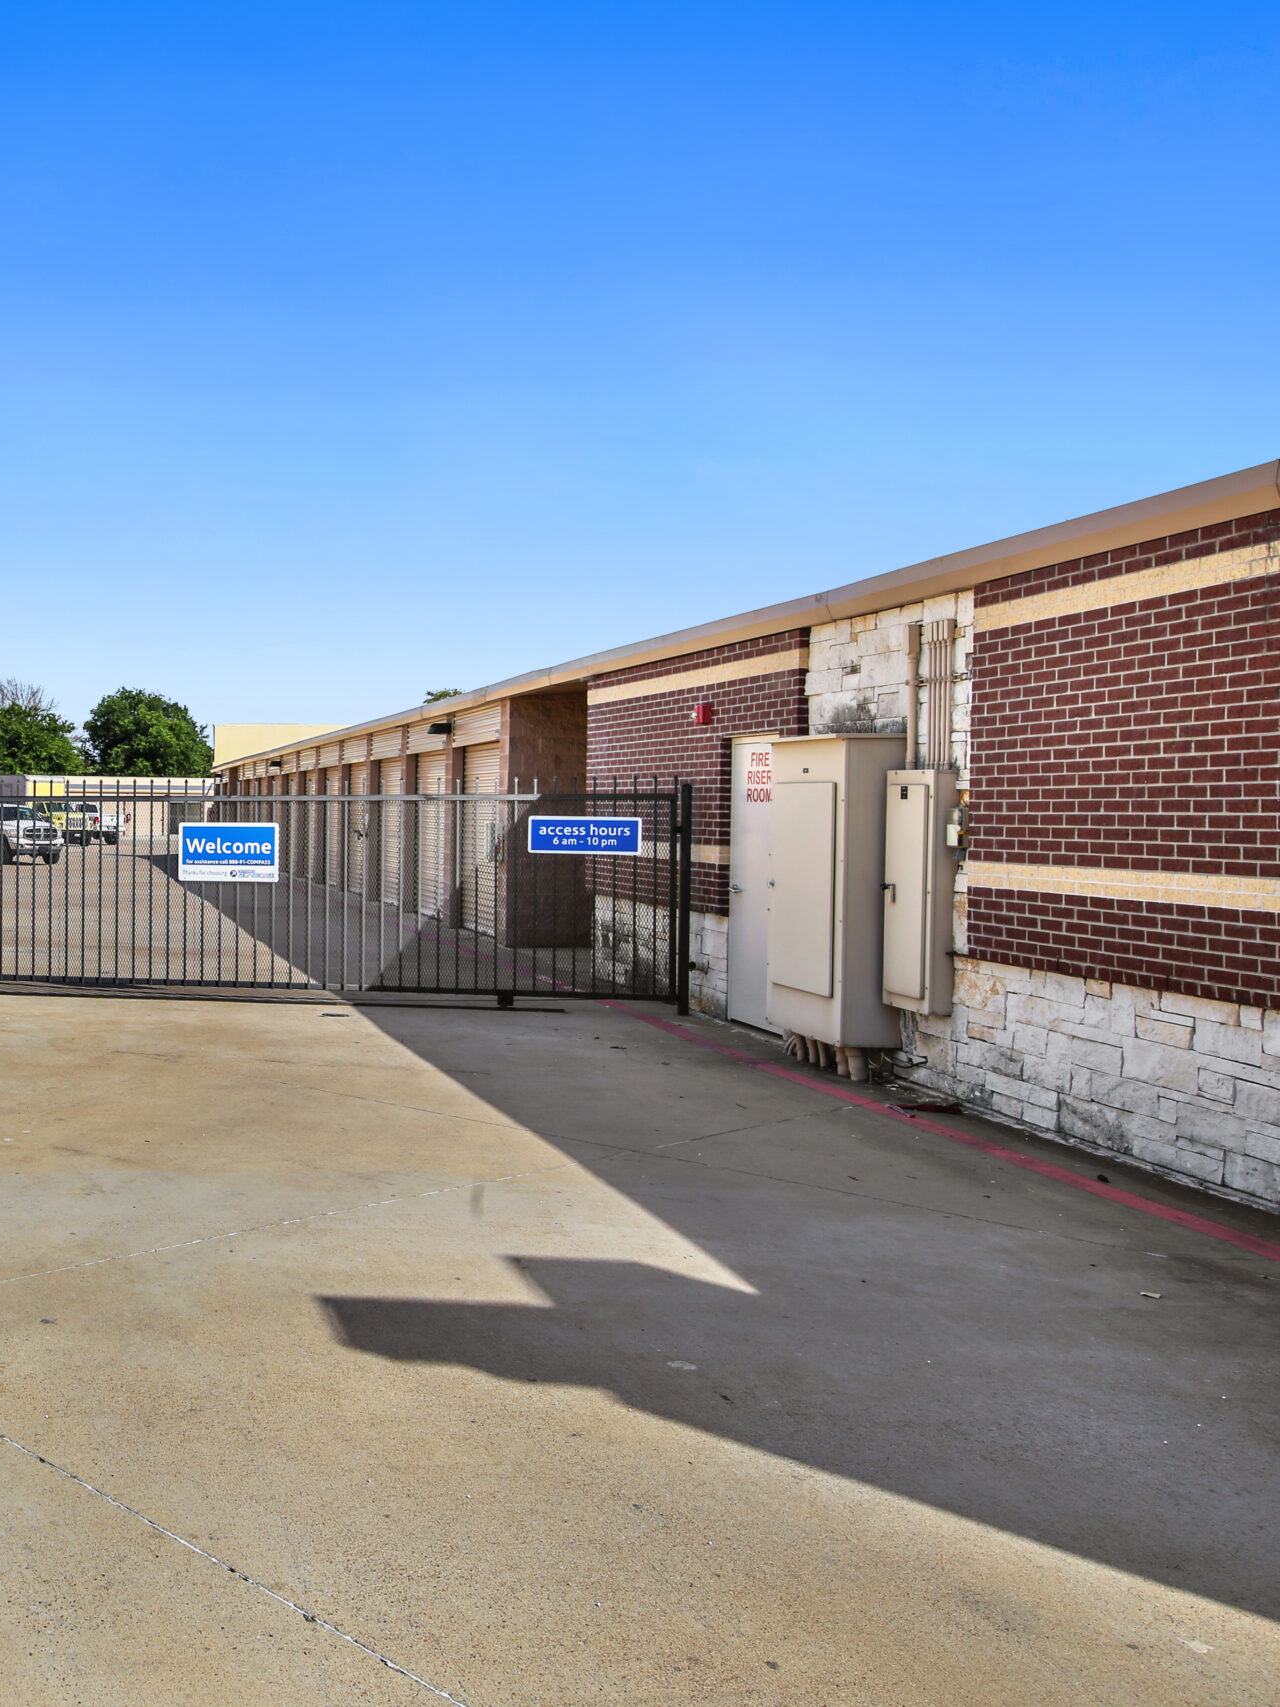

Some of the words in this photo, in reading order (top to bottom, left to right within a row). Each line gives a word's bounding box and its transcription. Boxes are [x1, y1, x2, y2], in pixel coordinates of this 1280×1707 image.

[751, 752, 770, 767] FIRE
[538, 826, 586, 835] access
[590, 824, 631, 836] hours
[186, 837, 272, 854] Welcome
[552, 837, 559, 845] 6
[586, 837, 599, 846] 10
[601, 838, 617, 848] pm
